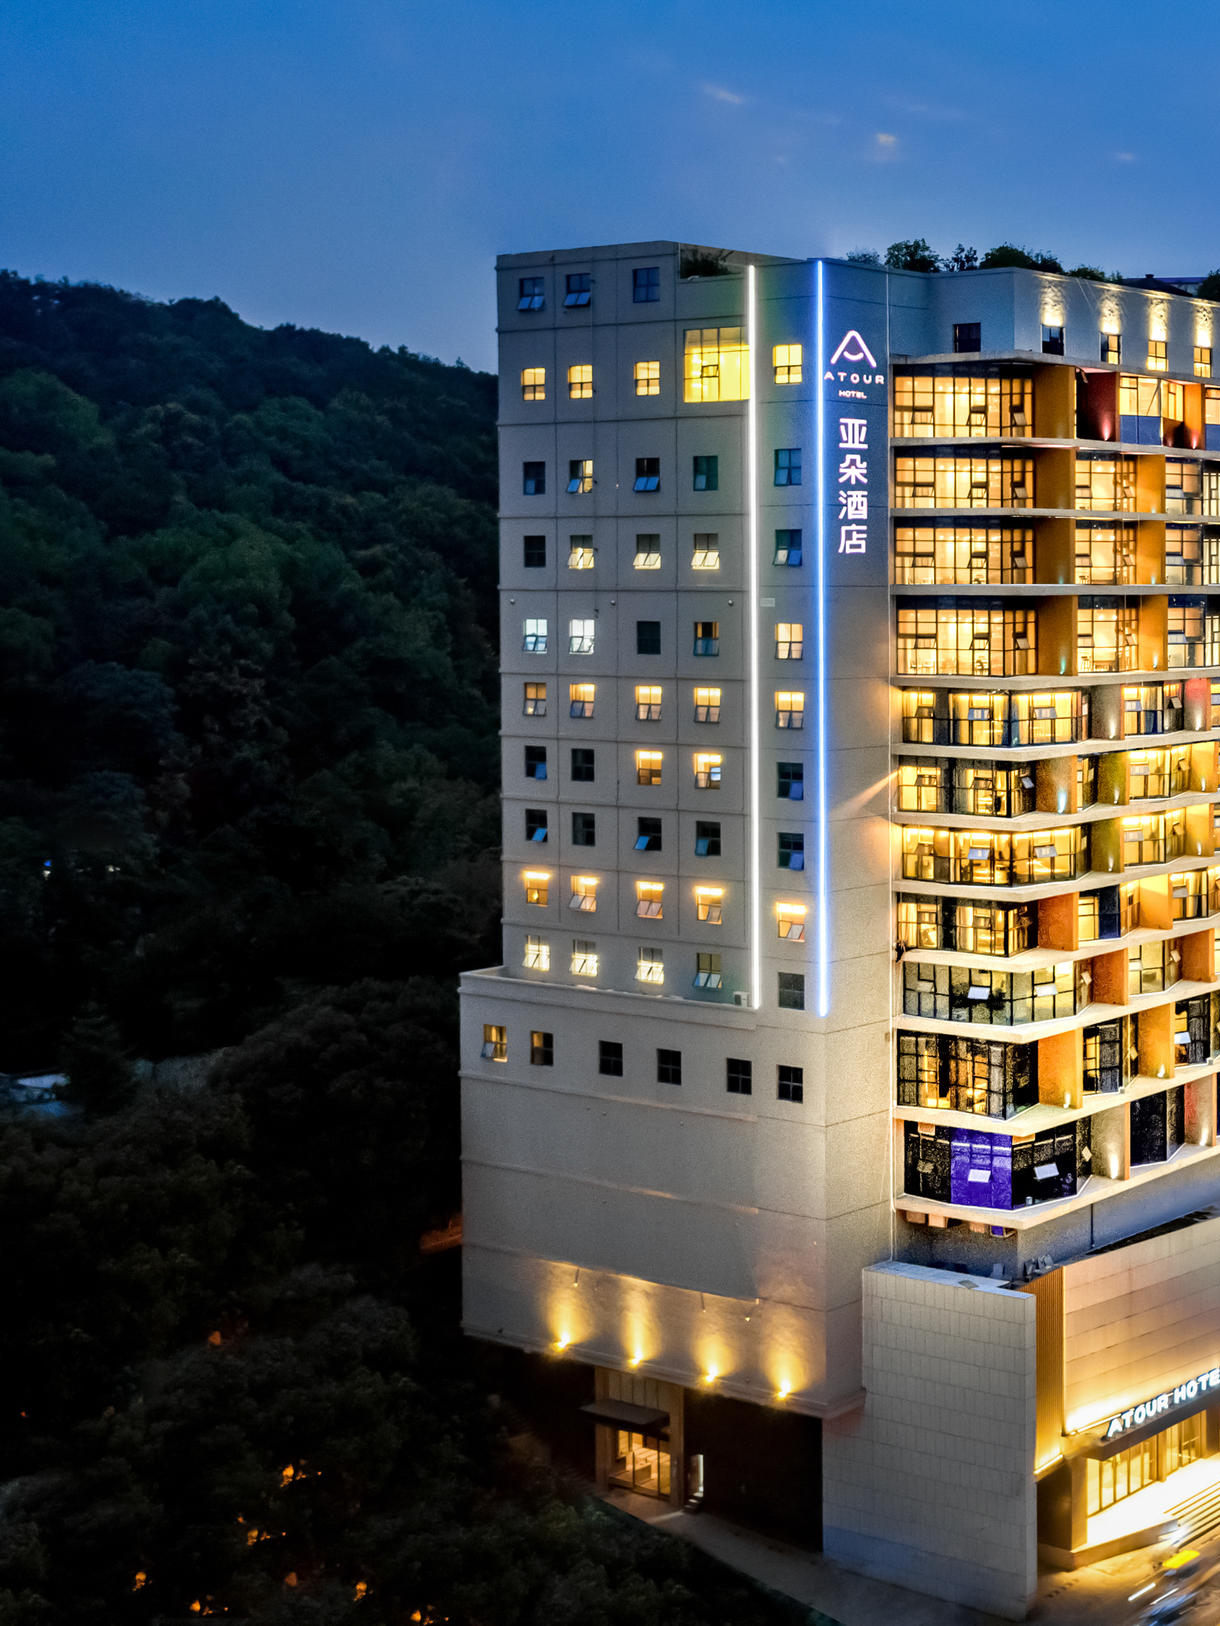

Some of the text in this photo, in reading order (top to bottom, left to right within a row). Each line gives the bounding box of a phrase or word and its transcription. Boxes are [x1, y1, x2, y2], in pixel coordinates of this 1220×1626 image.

[824, 371, 885, 385] ATOUR
[838, 389, 867, 399] HOTEL
[838, 417, 869, 555] 亚朵酒店
[1107, 1393, 1169, 1438] ATOUR
